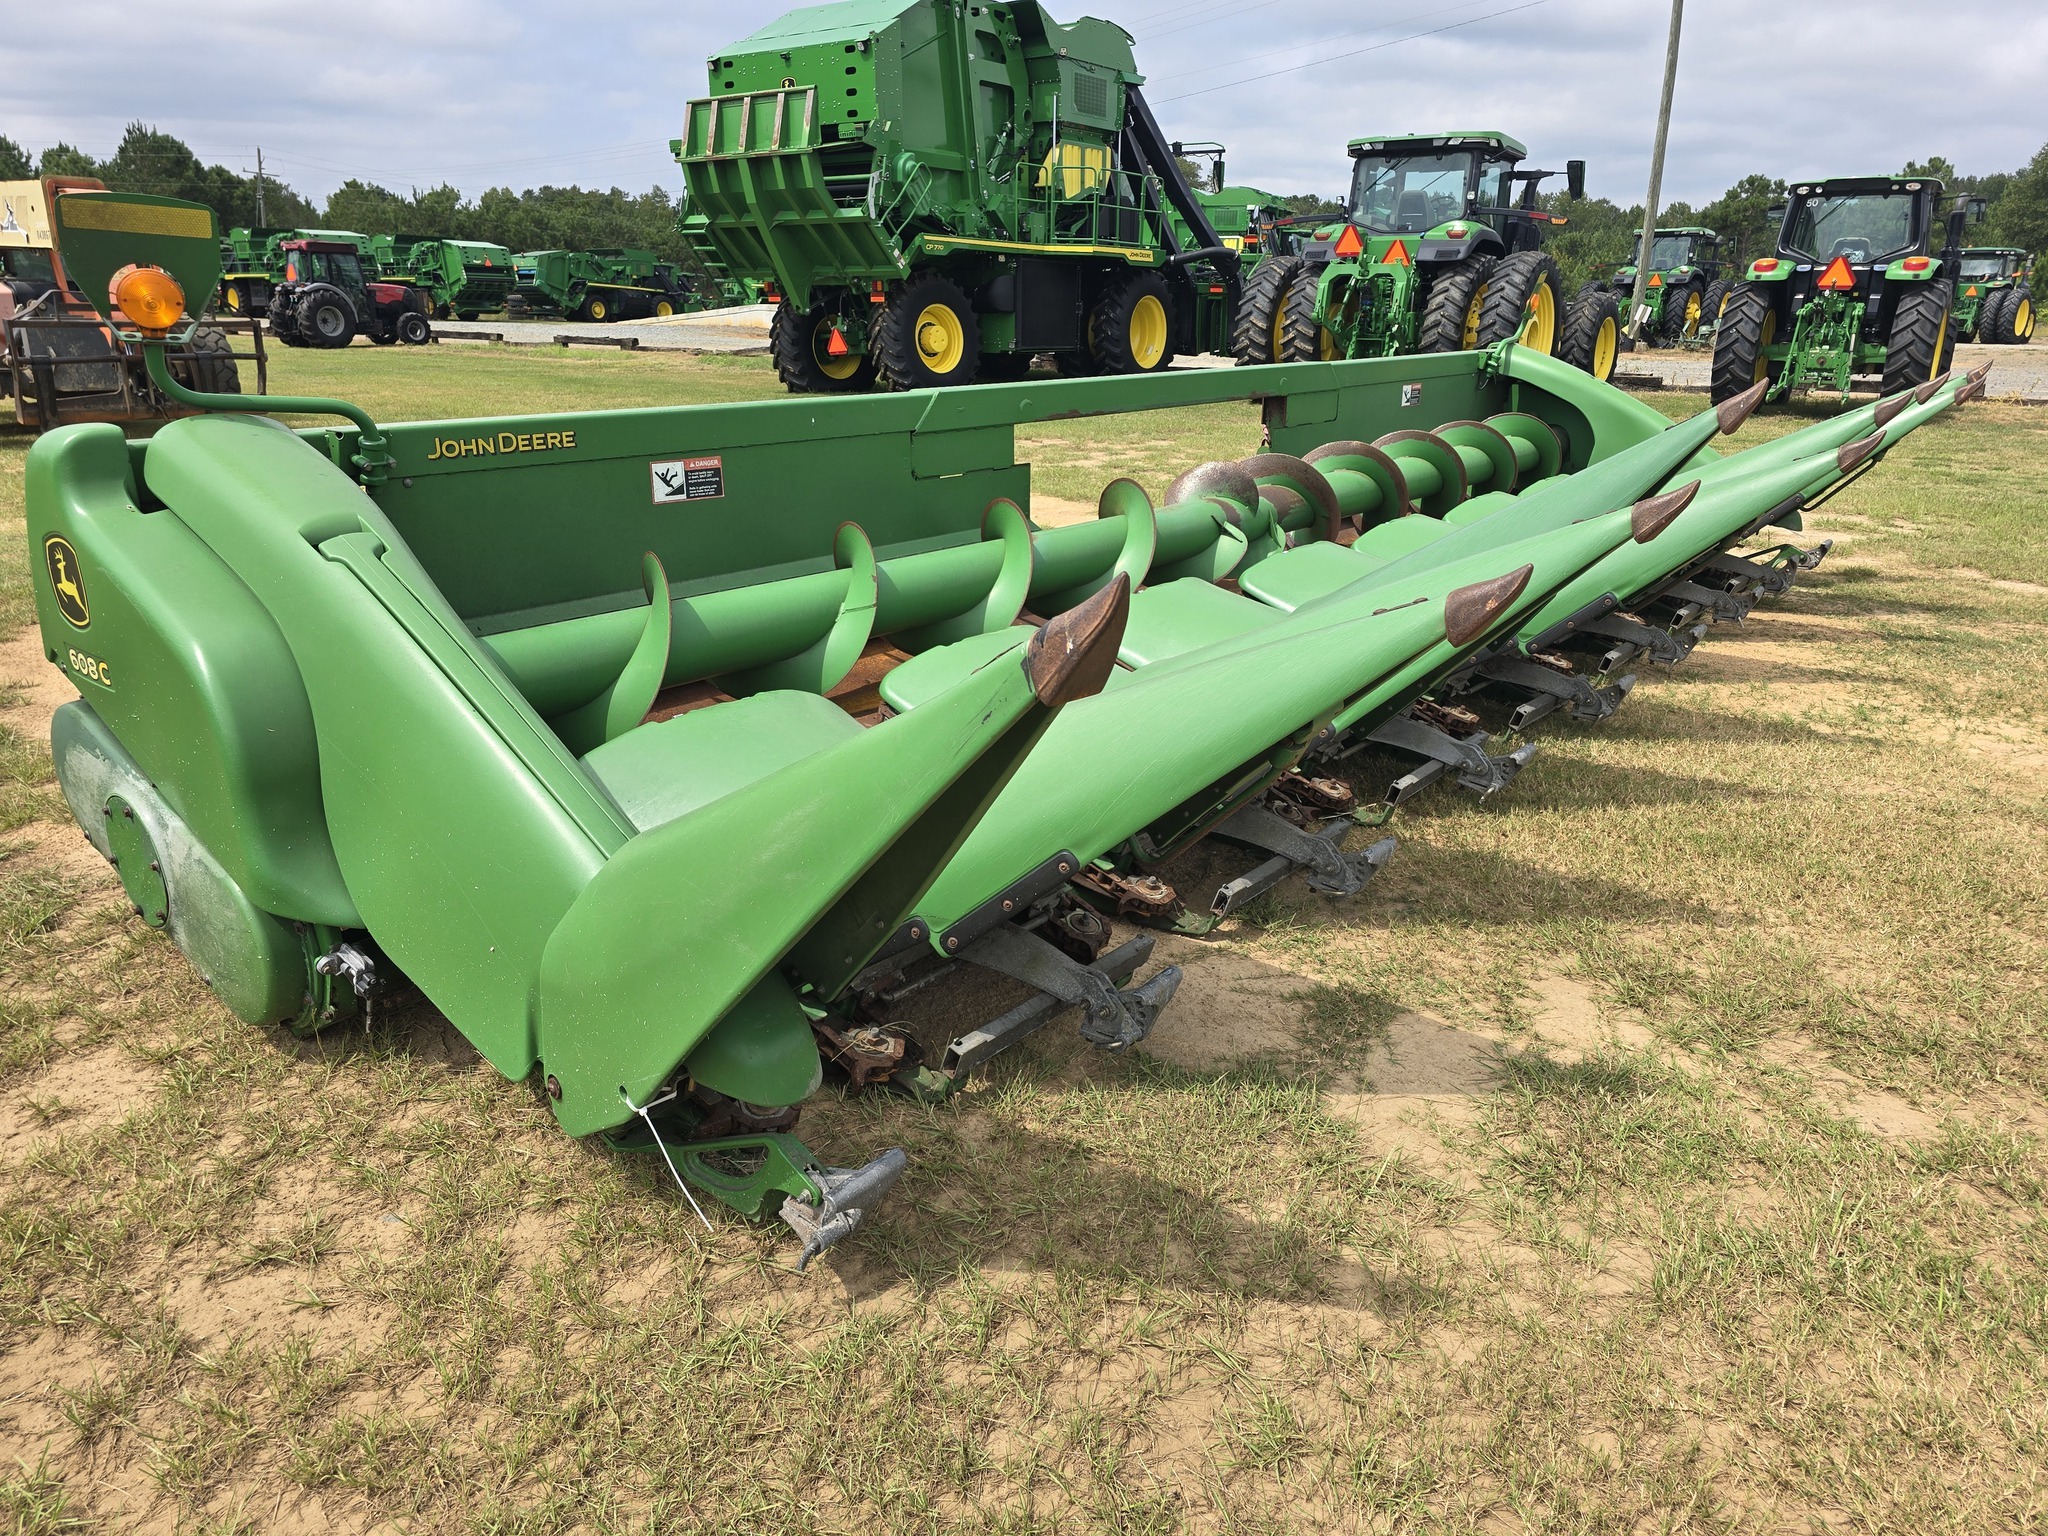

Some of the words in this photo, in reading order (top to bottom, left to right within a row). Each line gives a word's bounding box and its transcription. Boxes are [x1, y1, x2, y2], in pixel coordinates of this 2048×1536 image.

[1805, 198, 1819, 207] 50
[427, 437, 496, 461] JOHN
[497, 431, 577, 454] DEERE
[695, 459, 720, 467] DANGER
[69, 648, 111, 686] 608C
